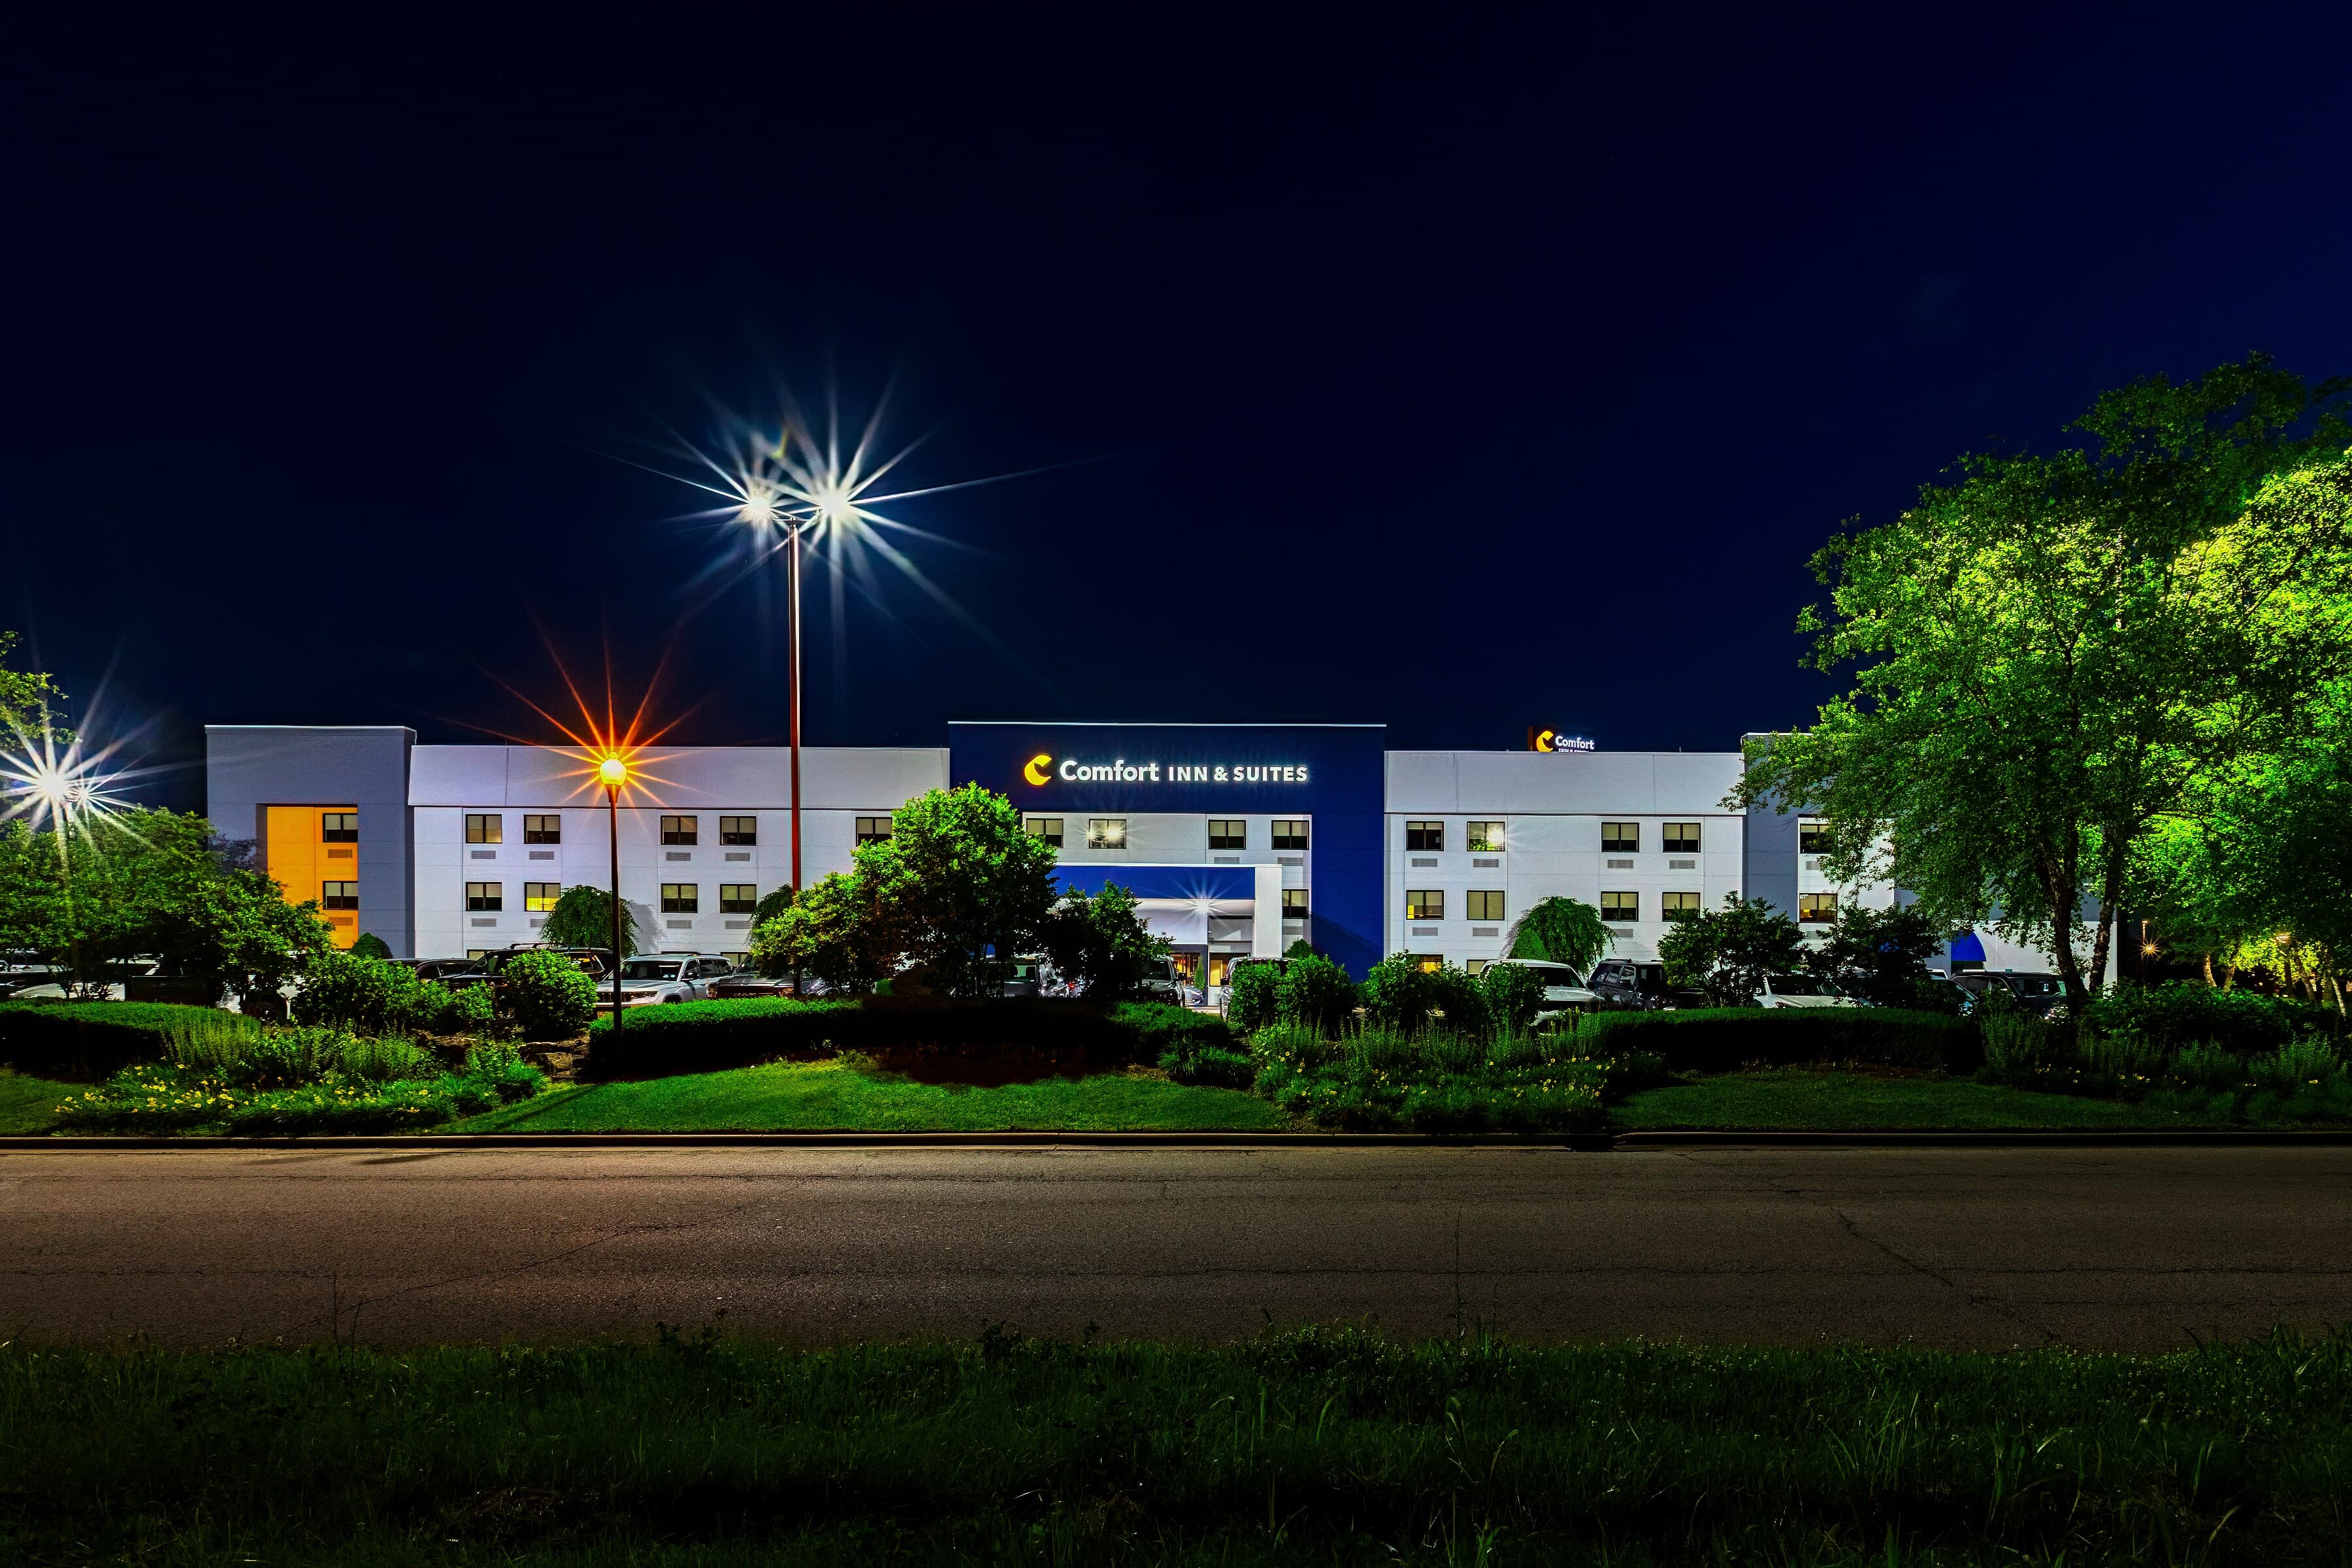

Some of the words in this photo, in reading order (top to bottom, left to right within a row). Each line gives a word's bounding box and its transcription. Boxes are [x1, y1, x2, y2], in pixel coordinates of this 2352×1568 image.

[1555, 736, 1595, 750] Comfort
[1060, 759, 1159, 781] Comfort
[1169, 766, 1207, 781] INN
[1213, 766, 1229, 781] &
[1233, 766, 1307, 781] SUITES
